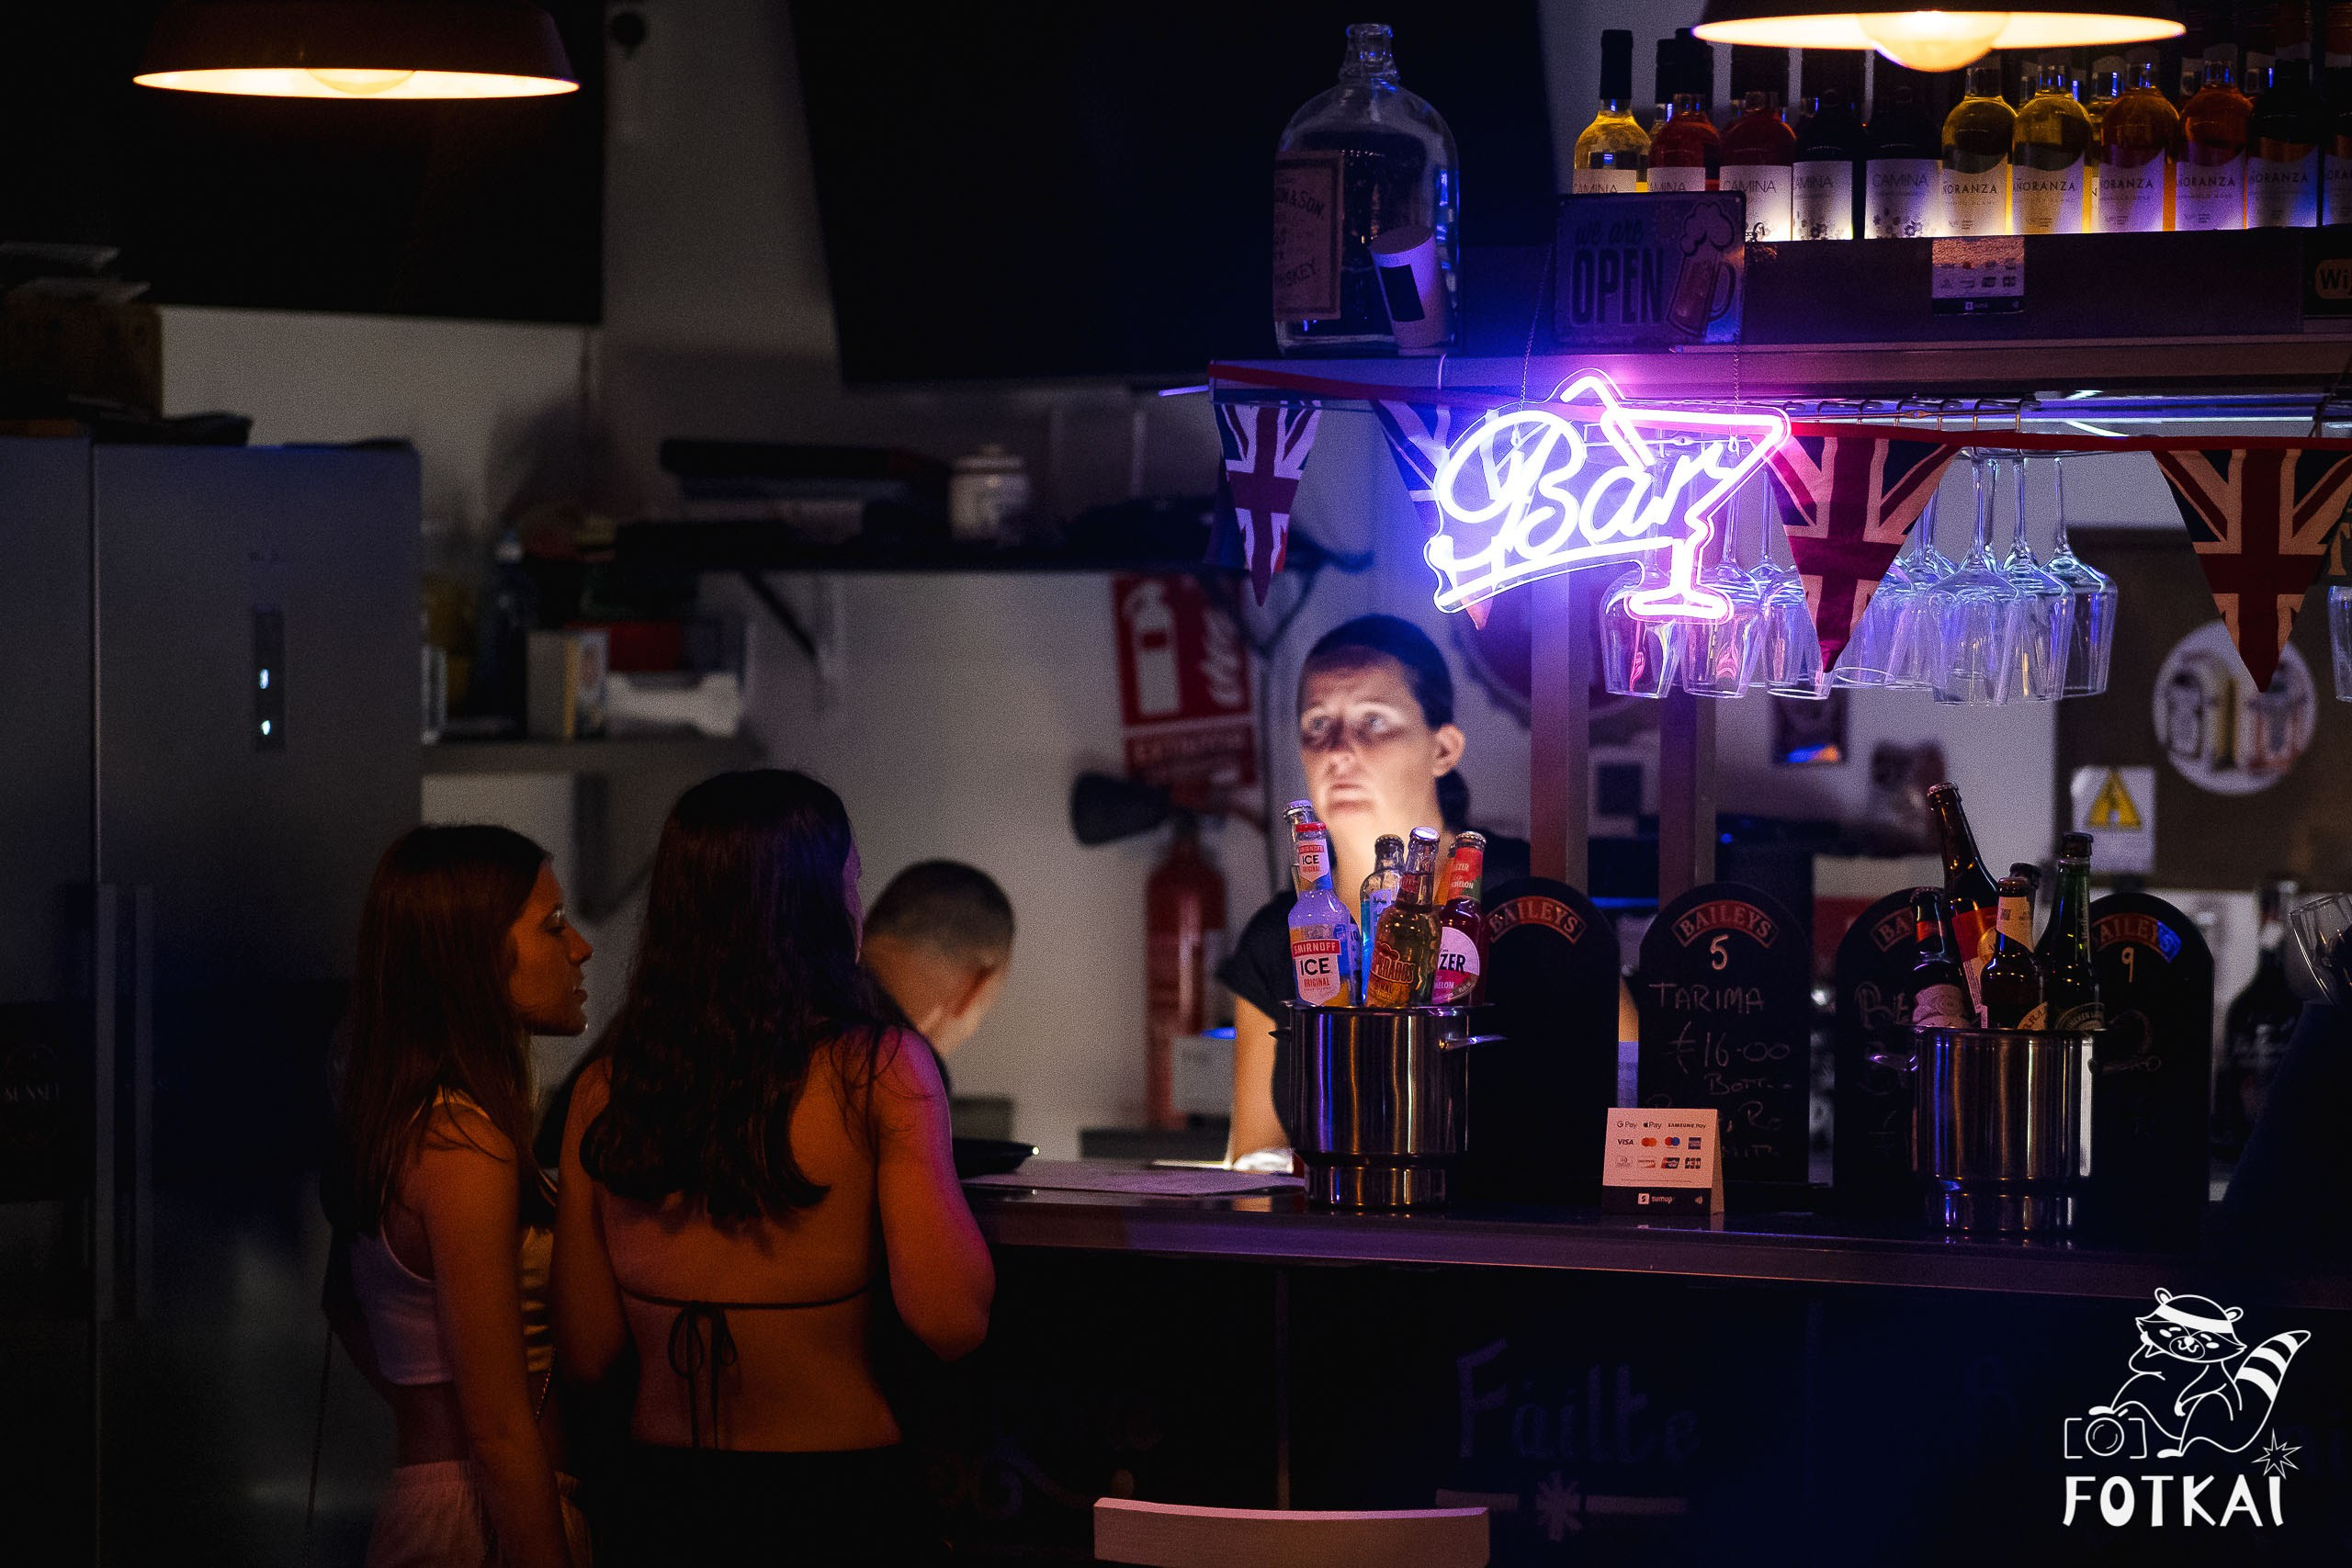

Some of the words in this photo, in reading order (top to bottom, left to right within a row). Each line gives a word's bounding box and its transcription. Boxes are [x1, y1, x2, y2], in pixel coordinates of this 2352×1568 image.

[1572, 248, 1663, 324] OPEN
[1438, 410, 1735, 562] Bar
[1302, 854, 1319, 865] ICE
[1488, 899, 1579, 935] BAILEYS
[1681, 904, 1771, 938] BAILEYS
[1293, 941, 1337, 955] SMIRNOFF
[1710, 933, 1729, 971] 5
[2120, 945, 2135, 984] 9
[1300, 957, 1331, 976] ICE
[1648, 980, 1764, 1014] TARIMA
[1625, 1122, 1637, 1130] Pay
[1649, 1122, 1662, 1130] Pay
